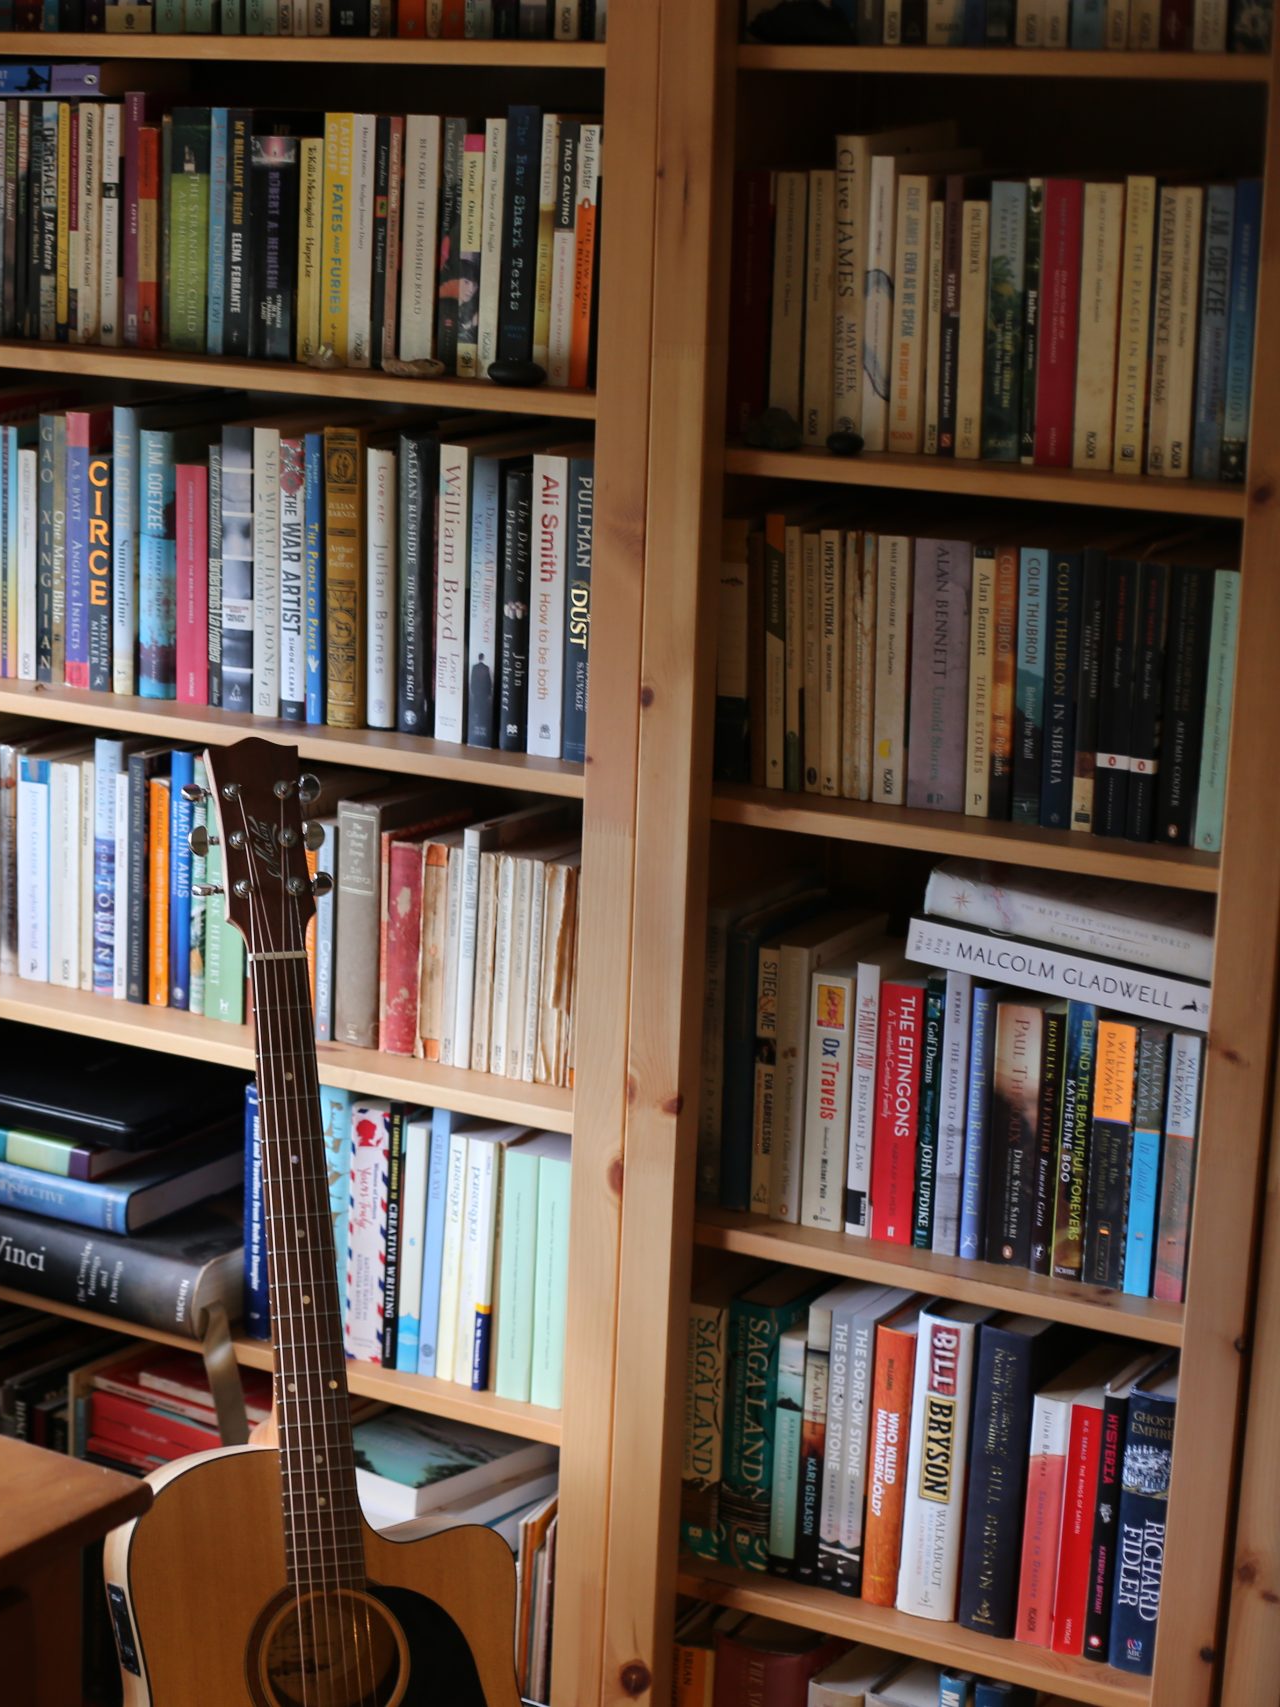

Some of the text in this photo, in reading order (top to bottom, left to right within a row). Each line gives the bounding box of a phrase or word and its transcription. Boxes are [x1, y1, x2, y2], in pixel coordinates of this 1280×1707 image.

[43, 128, 56, 203] DISGRACE
[327, 119, 350, 176] LAUREN GROFF
[516, 154, 528, 186] Raw
[561, 138, 573, 225] ITALO CALVINO
[582, 128, 596, 190] Paul Auster
[230, 121, 245, 313] MY BRILLIANT FRIEND ELENA FERRANTE
[331, 184, 344, 232] FATES
[511, 194, 526, 248] Shark
[837, 149, 855, 298] Clive JAMES
[329, 257, 343, 314] FURIES
[510, 258, 523, 311] Texts
[1205, 206, 1226, 316] J.M. COETZEE
[1124, 243, 1144, 433] THE PLACES IN BETWEEN
[71, 487, 81, 521] BYATT
[147, 441, 162, 529] J.M. COETZEE
[407, 441, 419, 565] SALMAN RUSHDIE
[540, 475, 559, 583] Ali Smith
[575, 476, 592, 568] PULLMAN
[53, 511, 64, 624] One Man's Bible
[72, 540, 81, 586] ANGELS
[88, 460, 111, 606] CIRCE
[282, 493, 300, 637] THE WAR ARTIST
[439, 464, 461, 641] William Boyd
[71, 602, 81, 649] INSECTS
[116, 539, 130, 628] Summertime
[307, 522, 319, 651] THE PEOPLE OF PAPER
[375, 543, 388, 674] Julian Barnes
[569, 589, 589, 650] DUST
[1025, 557, 1041, 665] COLIN THUBRON
[90, 615, 109, 673] MADELINE MILLER
[406, 576, 417, 702] THE MOOR'S LAST SIGH
[538, 593, 552, 701] How to be both
[929, 546, 950, 781] ALAN BENNETT Untold Stories
[974, 572, 991, 774] Alan Bennett THREE STORIES
[1050, 561, 1070, 785] COLIN THUBRON IN SIBERIA
[1023, 686, 1036, 759] Behind the Wall
[177, 800, 189, 898] MARTIN AMIS
[762, 961, 778, 996] STIEG
[956, 941, 1174, 1009] MALCOLM GLADWELL
[761, 1012, 777, 1030] ME
[925, 1021, 938, 1083] Golf Dreams
[820, 1038, 841, 1120] Ox Travels
[855, 1009, 877, 1171] FAMILY LAW BENJAMIN LAW
[894, 996, 916, 1137] THE EITINGONS
[1102, 1032, 1128, 1113] WILLIAM DALRYMPLE
[1137, 1040, 1165, 1123] WILLIAM DALRYMPLE
[1171, 1050, 1197, 1128] WILLIAM DALRYMPLE
[761, 1072, 774, 1155] EVA GABRIELSSON
[1060, 1079, 1076, 1183] KATHERINE BOO
[1068, 1020, 1093, 1241] BEHIND THE BEAUTIFUL FOREVERS
[918, 1142, 934, 1228] JOHN UPDIKE
[176, 1279, 191, 1323] TASCHEN
[385, 1203, 399, 1318] CREATIVE WRITING
[827, 1323, 848, 1471] THE SORROW STONE
[848, 1328, 868, 1476] THE SORROW STONE
[923, 1331, 960, 1495] BILL BRYSON
[871, 1409, 888, 1516] HAMMARSKJÖLD?
[884, 1412, 900, 1484] WHO KILLED
[1103, 1413, 1119, 1485] HYSTERIA
[802, 1457, 819, 1537] KÁRI GÍSLASON
[932, 1510, 947, 1588] WALKABOUT
[1118, 1523, 1144, 1607] FIDLER
[1138, 1519, 1165, 1622] RICHARD
